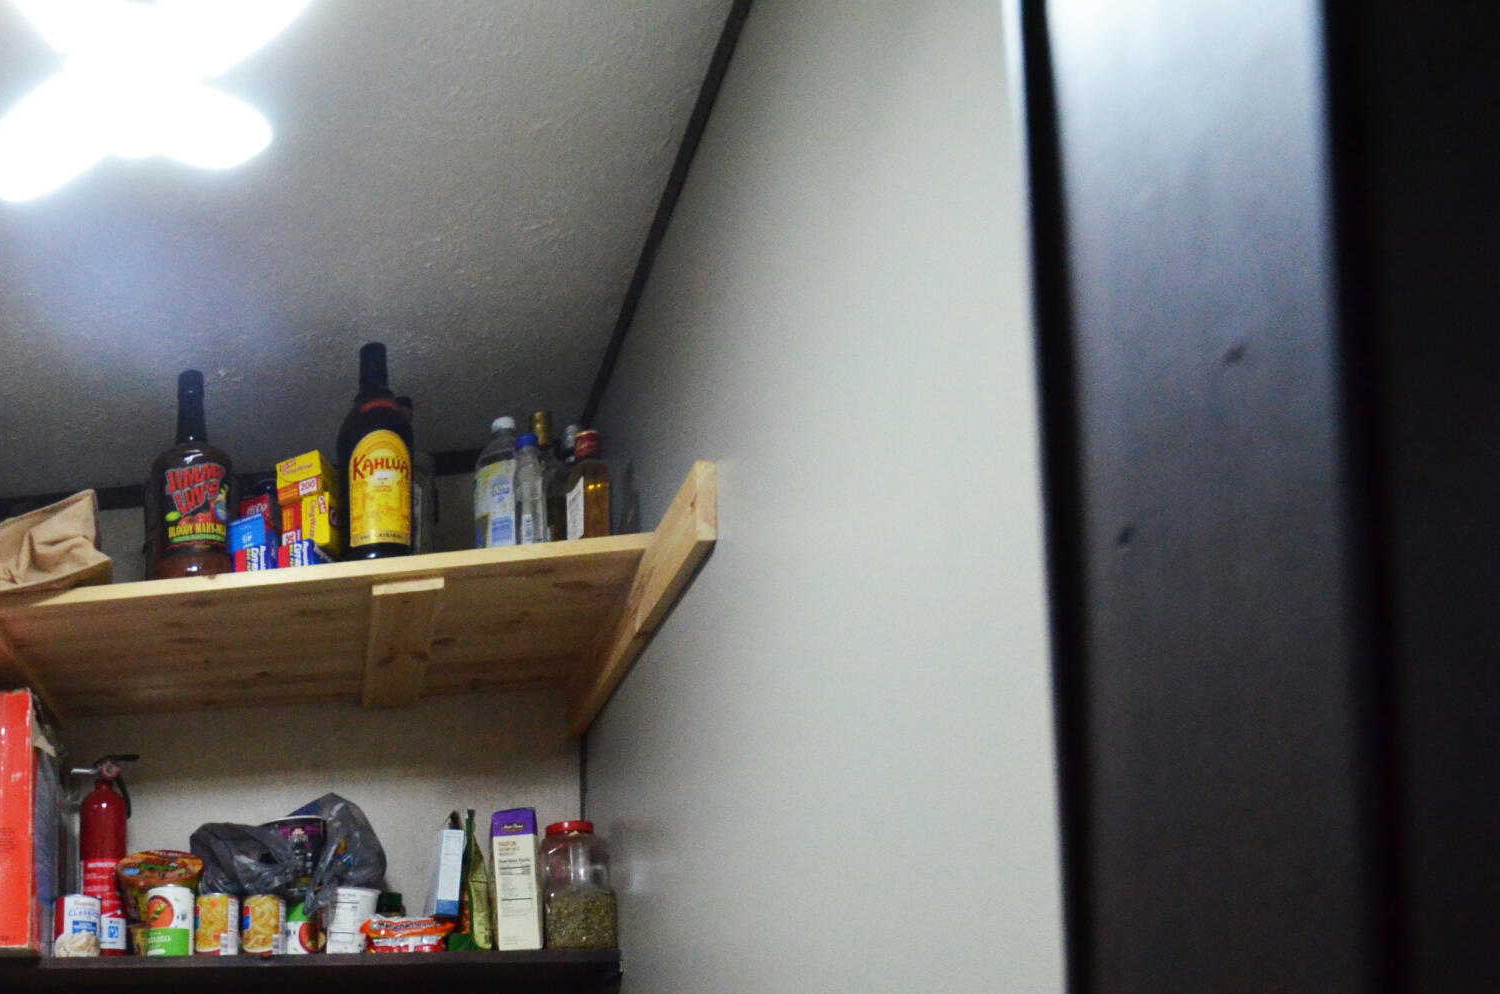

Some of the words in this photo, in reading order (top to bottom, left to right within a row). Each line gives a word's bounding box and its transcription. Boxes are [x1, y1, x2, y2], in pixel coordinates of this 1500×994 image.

[352, 454, 410, 481] KAHLÚA
[300, 480, 317, 493] 200
[379, 920, 415, 930] Maruchan
